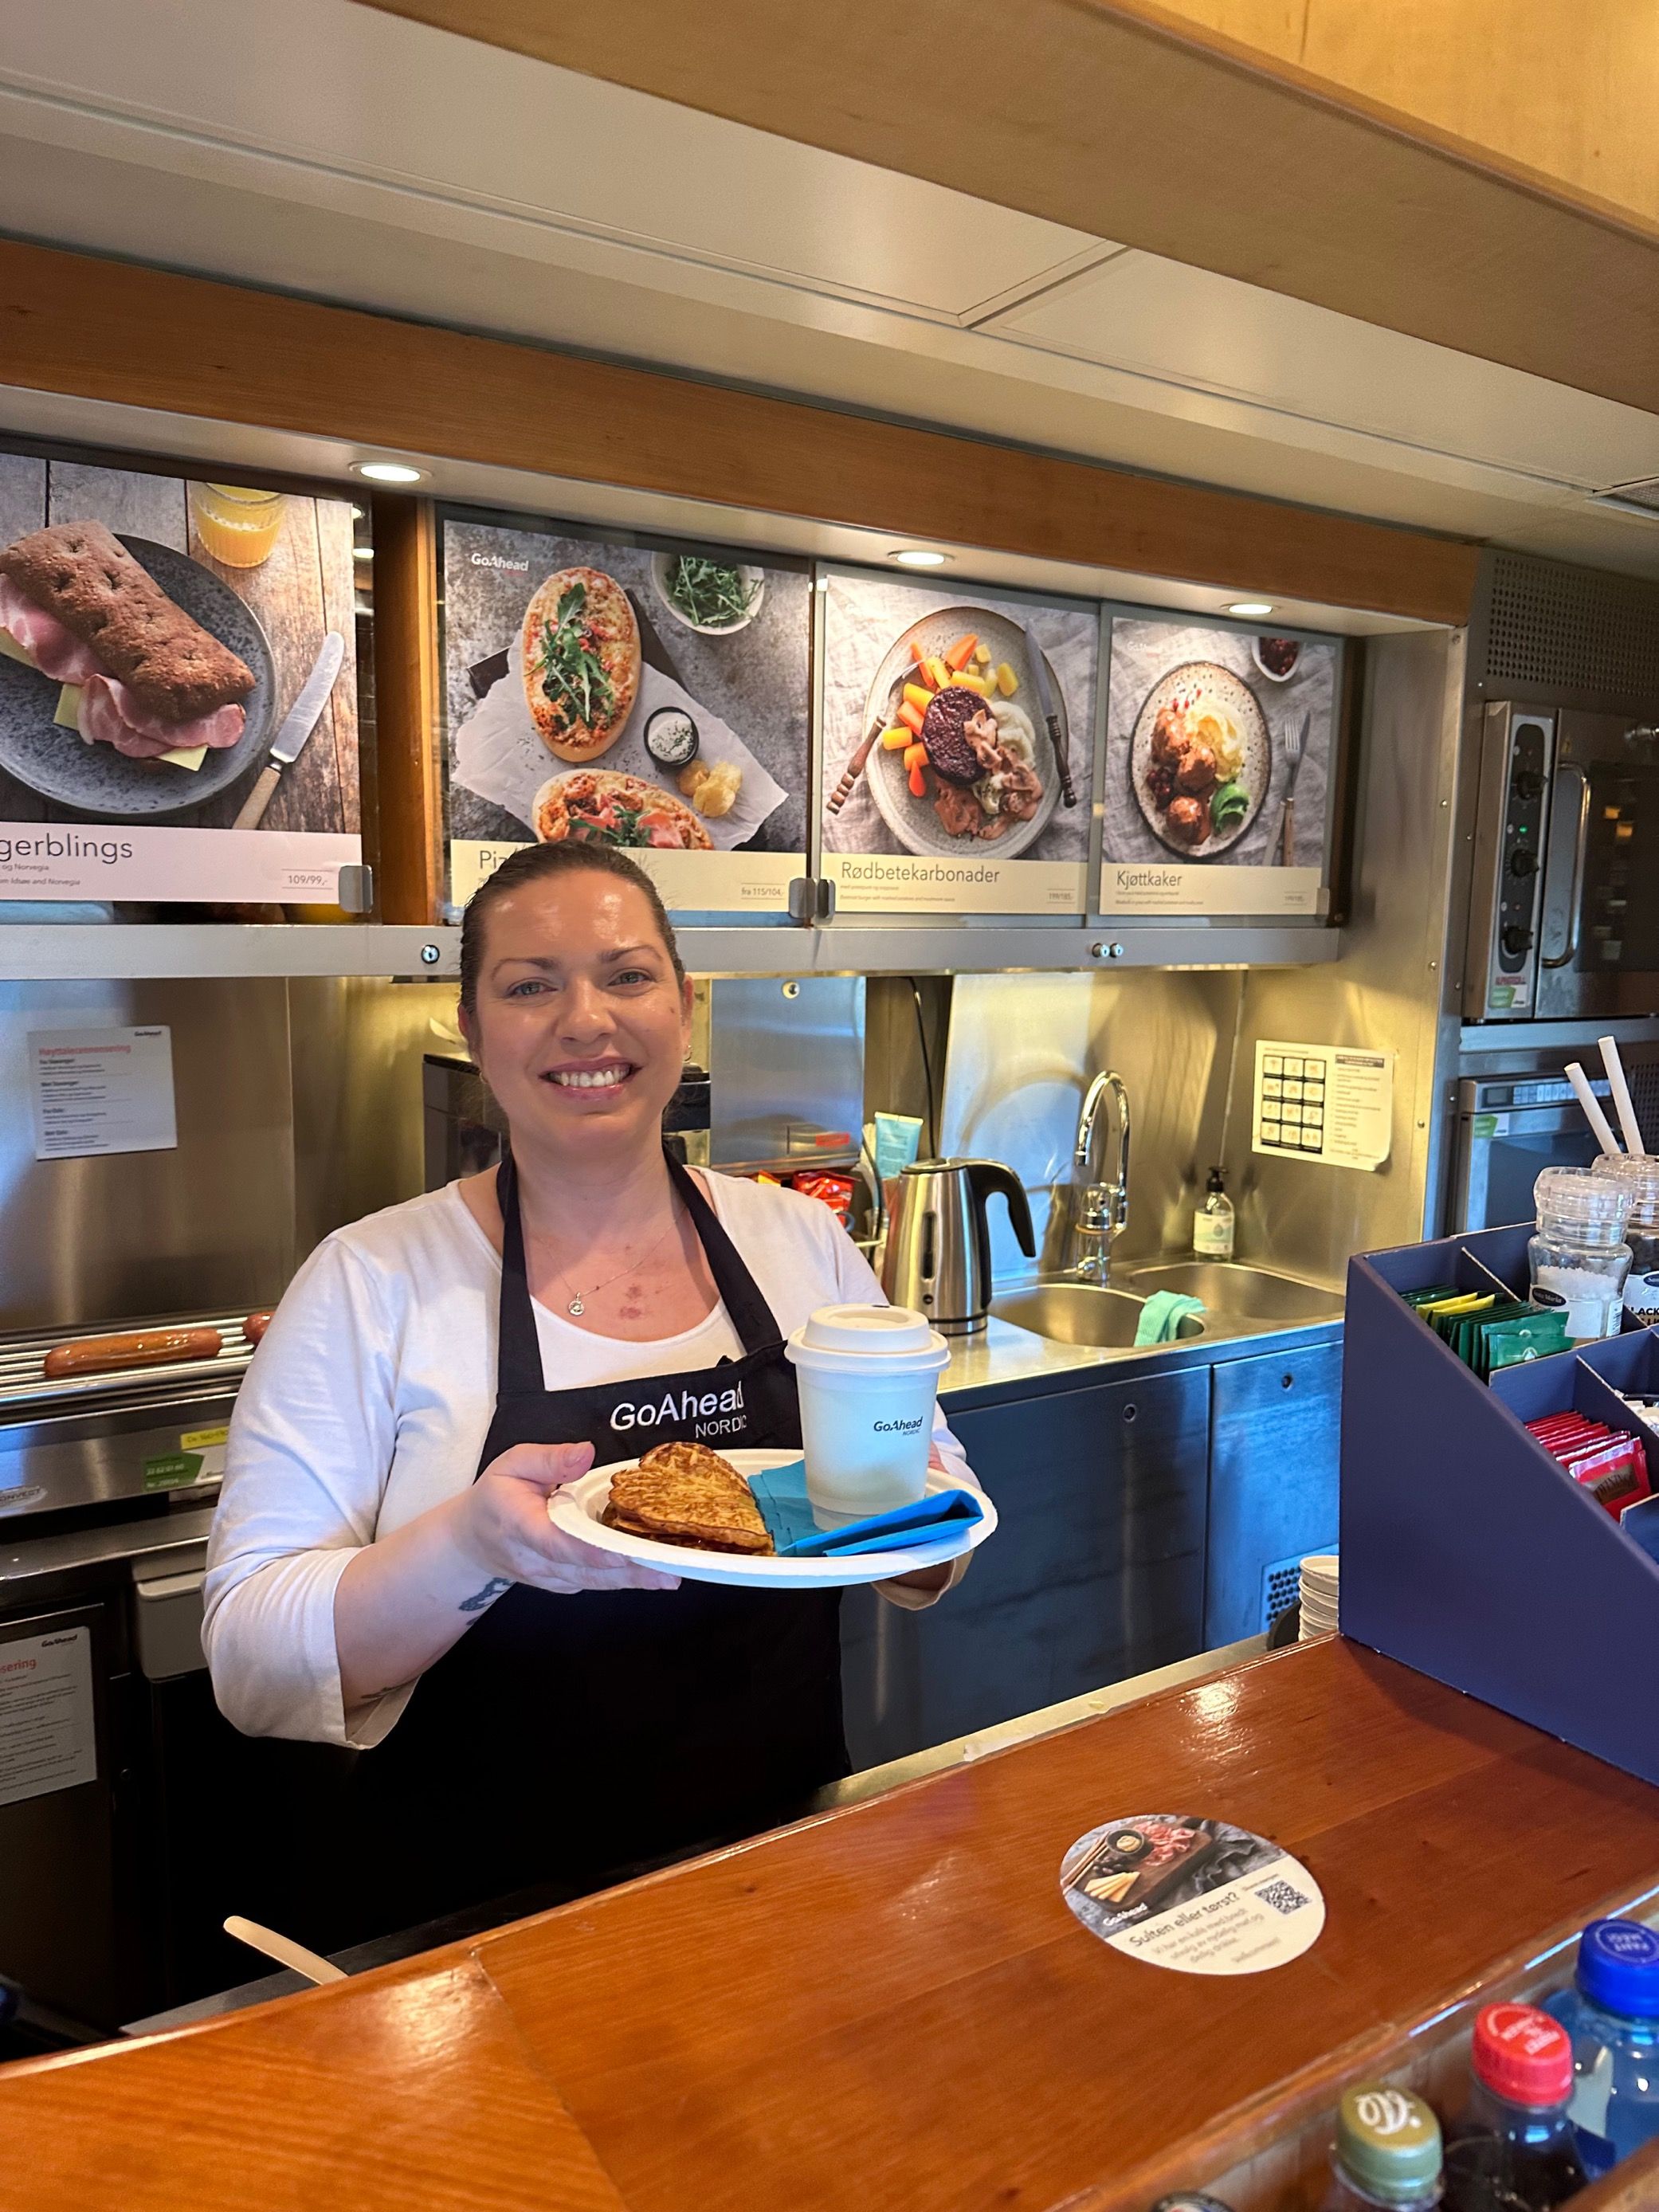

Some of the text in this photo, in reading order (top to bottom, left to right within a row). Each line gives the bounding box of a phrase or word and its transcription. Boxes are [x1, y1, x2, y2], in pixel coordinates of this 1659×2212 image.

[470, 552, 529, 571] GoAhead
[0, 833, 132, 864] gerblings
[480, 850, 508, 869] Pi
[841, 861, 1000, 882] Rødbetekarbonader
[1117, 870, 1182, 890] Kjøttkaker
[610, 1380, 745, 1430] GoAhead
[873, 1416, 923, 1432] GoAhead
[1175, 1910, 1203, 1927] eller
